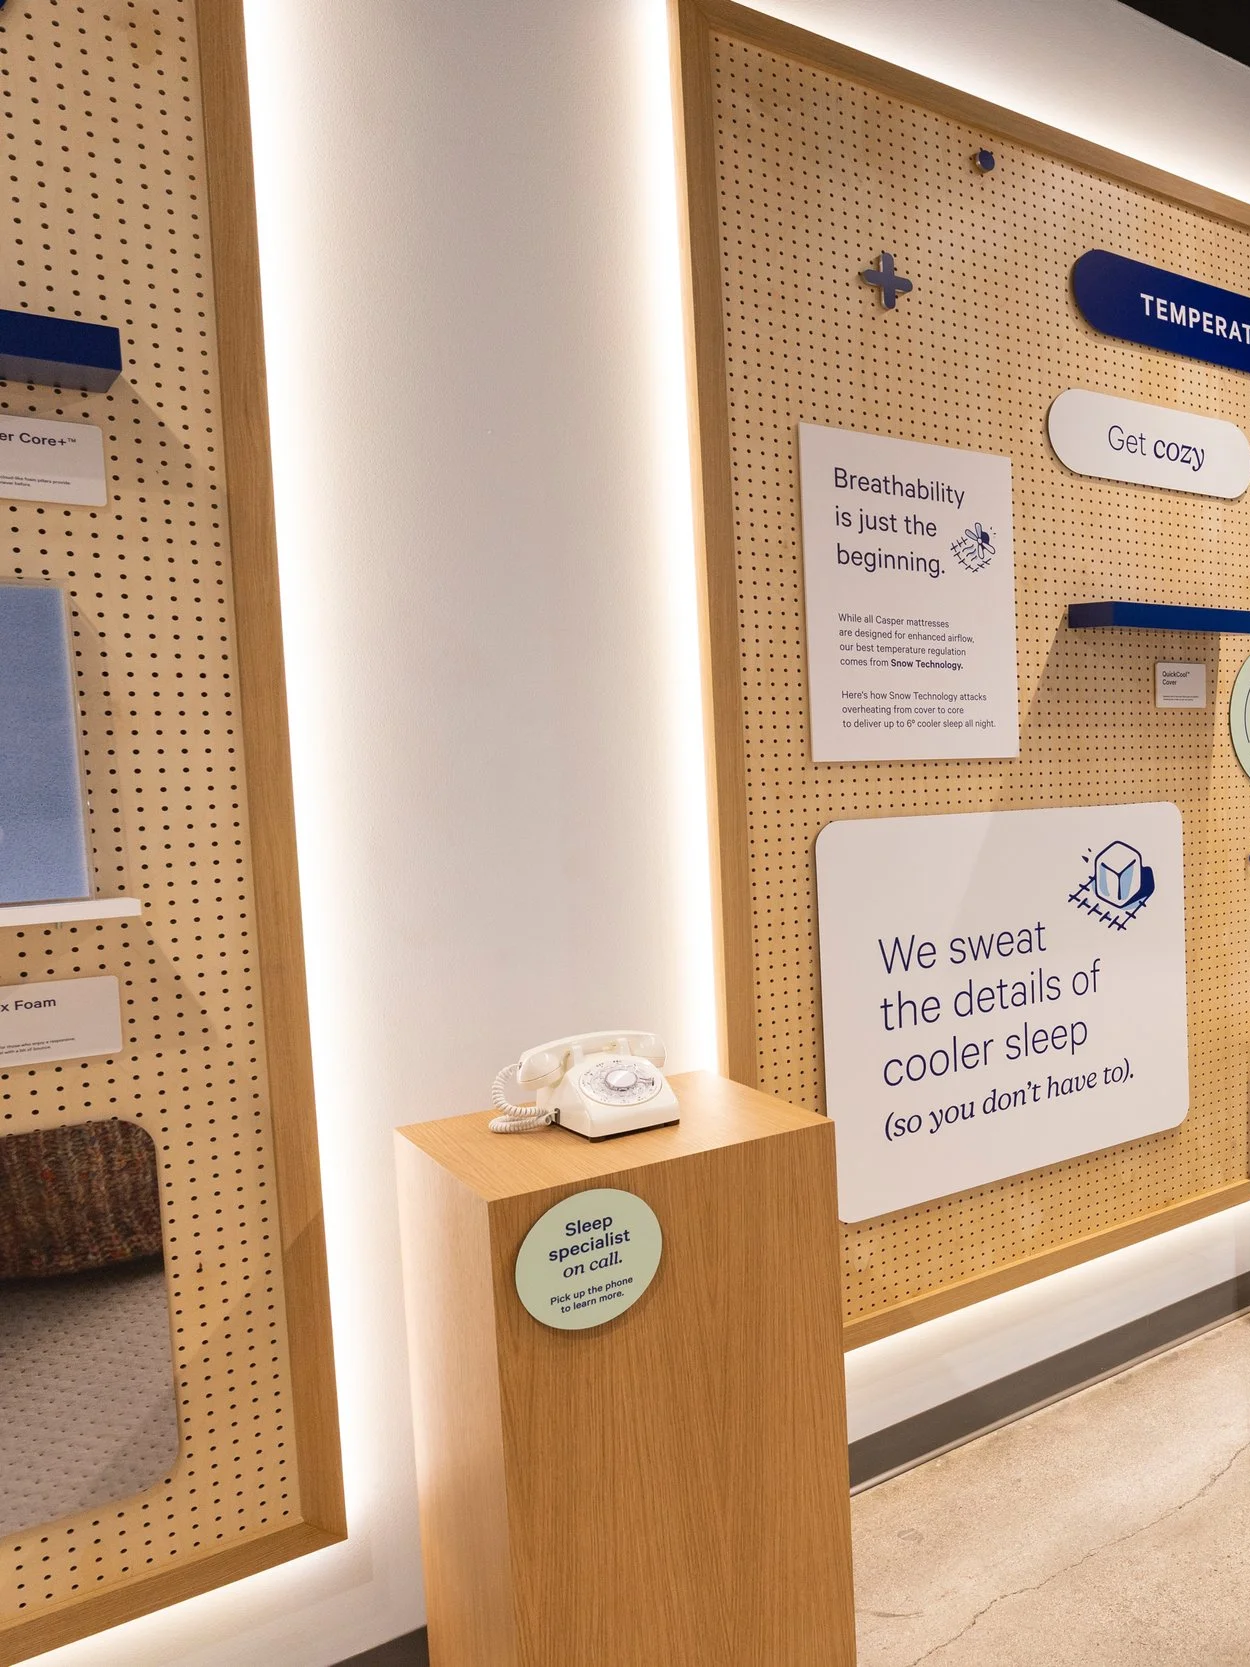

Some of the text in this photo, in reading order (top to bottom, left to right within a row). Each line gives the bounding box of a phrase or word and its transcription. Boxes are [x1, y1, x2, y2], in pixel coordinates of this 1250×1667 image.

[1108, 425, 1205, 472] Get cozy
[834, 467, 965, 509] Breathability
[836, 505, 937, 536] is just the
[837, 543, 945, 578] beginning.
[838, 613, 949, 628] While all Casper mattresses
[855, 629, 892, 640] designed
[894, 631, 905, 639] for
[908, 632, 945, 641] enhanced
[947, 634, 975, 643] airflow,
[856, 643, 874, 652] best
[876, 645, 925, 654] temperature
[928, 647, 966, 656] regulation
[870, 659, 888, 667] from
[891, 659, 913, 668] Snow
[916, 660, 963, 670] Technology.
[842, 691, 987, 702] Here's how Snow Technology attacks
[842, 705, 891, 715] overheating
[894, 705, 912, 714] from
[854, 719, 881, 727] deliver
[884, 721, 894, 729] up
[917, 719, 940, 727] cooler
[943, 719, 963, 728] sleep
[975, 720, 996, 728] night.
[878, 922, 1047, 974] We sweat
[15, 999, 56, 1010] Foam
[880, 958, 1101, 1031] the details of
[883, 1020, 1088, 1087] cooler sleep
[885, 1111, 922, 1141] (so
[929, 1101, 975, 1134] you
[1047, 1071, 1097, 1099] have
[1103, 1058, 1134, 1085] to).
[566, 1216, 613, 1236] Sleep
[549, 1230, 630, 1262] specialist
[563, 1251, 623, 1278] on call.
[551, 1277, 633, 1305] Pick up the phone
[561, 1292, 624, 1313] to learn more.
